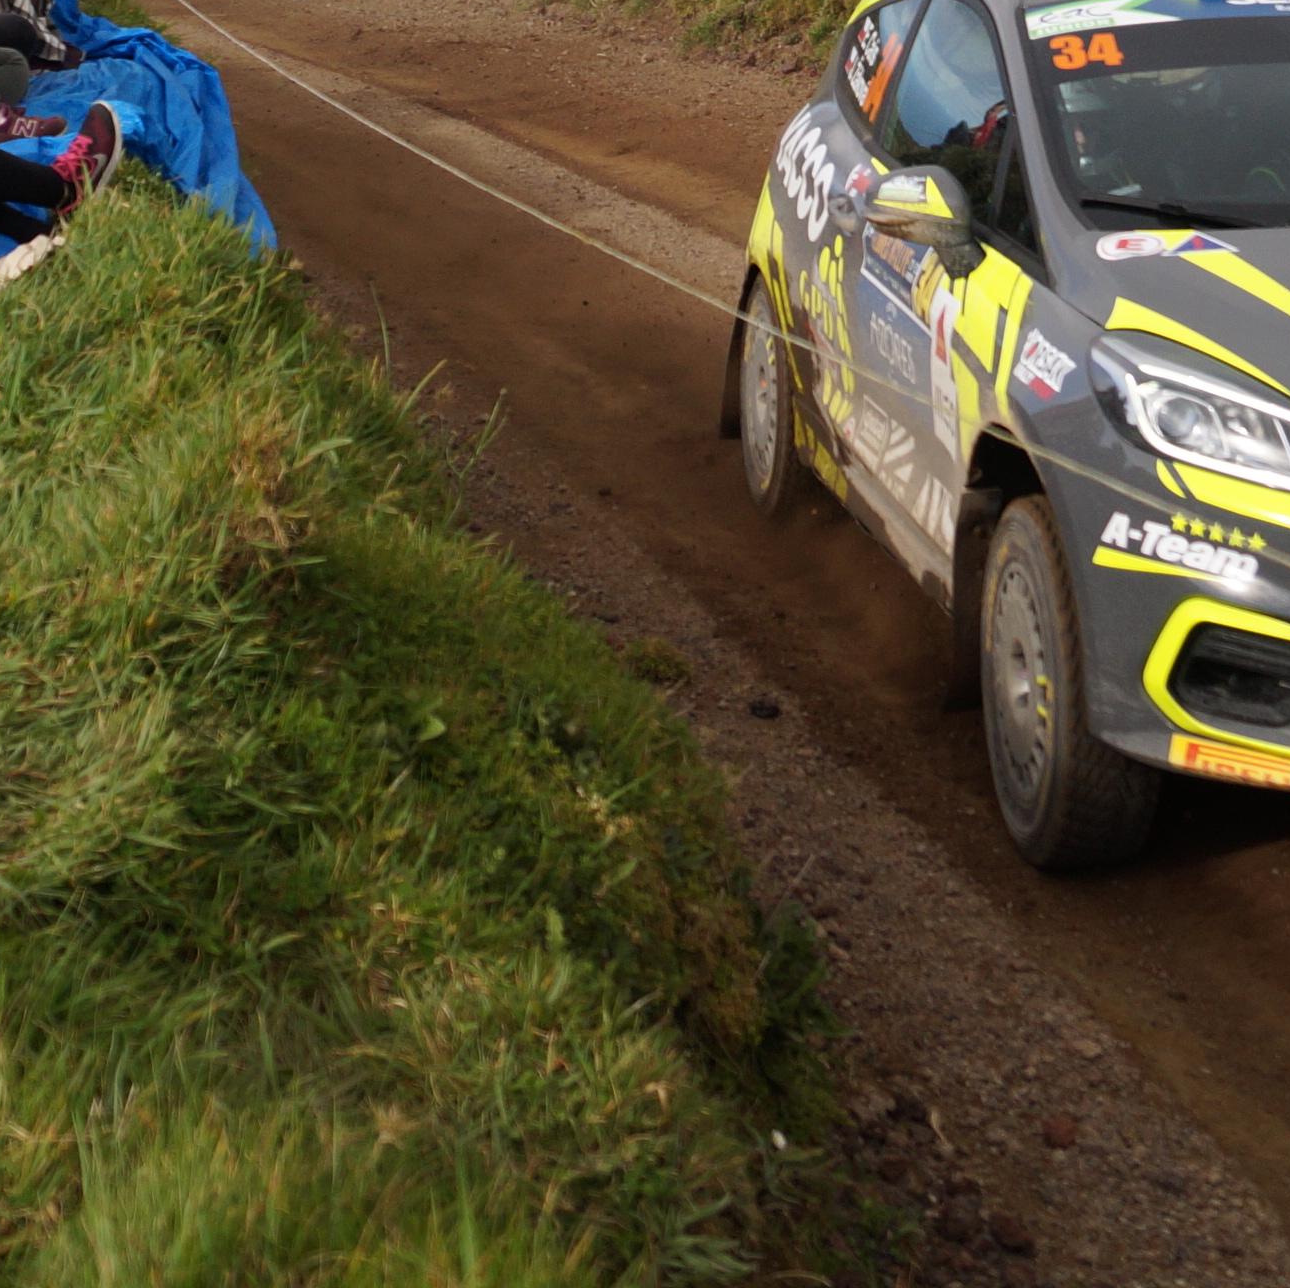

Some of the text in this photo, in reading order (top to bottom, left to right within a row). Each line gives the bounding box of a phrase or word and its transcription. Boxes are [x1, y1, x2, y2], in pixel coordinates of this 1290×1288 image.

[1049, 32, 1125, 70] 34
[776, 103, 836, 242] YACCO
[1101, 511, 1259, 583] A-Team
